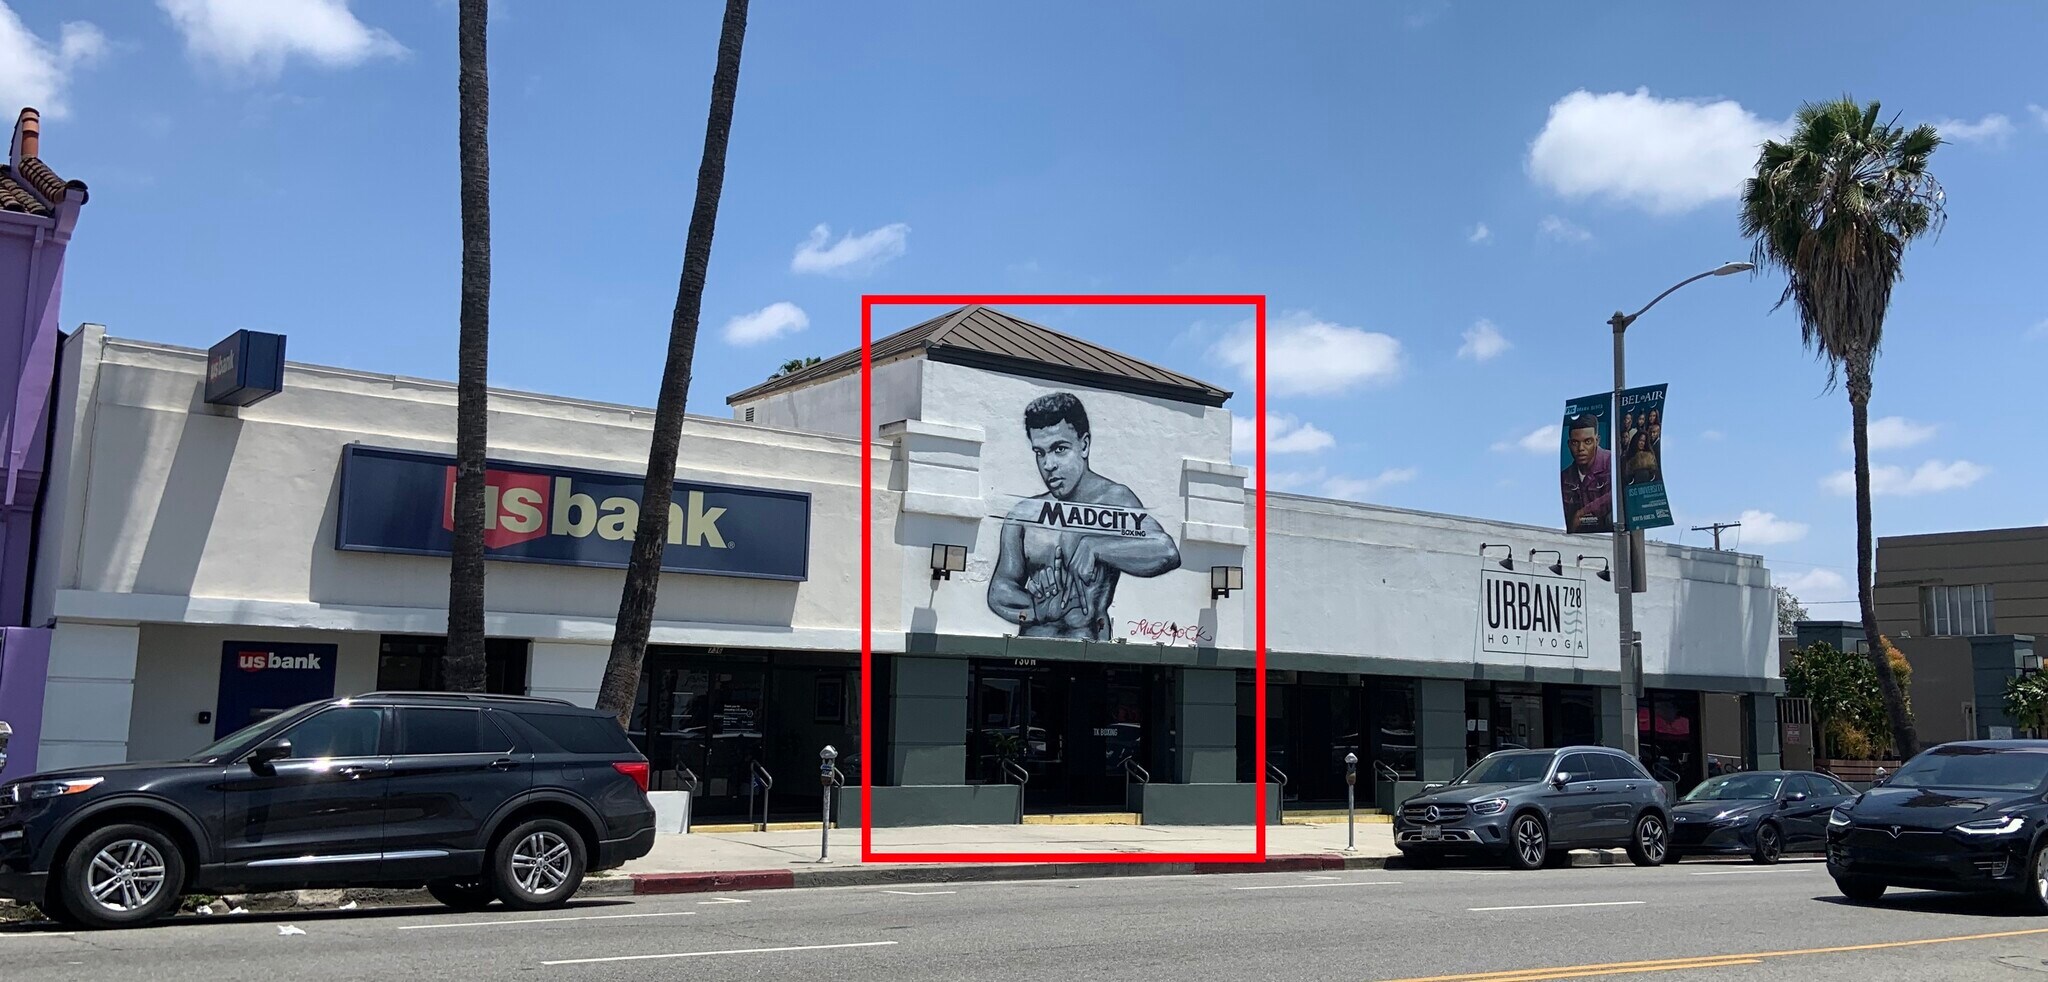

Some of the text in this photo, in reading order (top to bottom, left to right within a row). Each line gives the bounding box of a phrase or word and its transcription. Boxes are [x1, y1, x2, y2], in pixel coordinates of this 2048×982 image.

[1037, 501, 1148, 531] MADCITY
[1121, 529, 1146, 537] BOXING
[1487, 578, 1582, 633] URBAN 728
[1487, 633, 1584, 649] HOT YOGA
